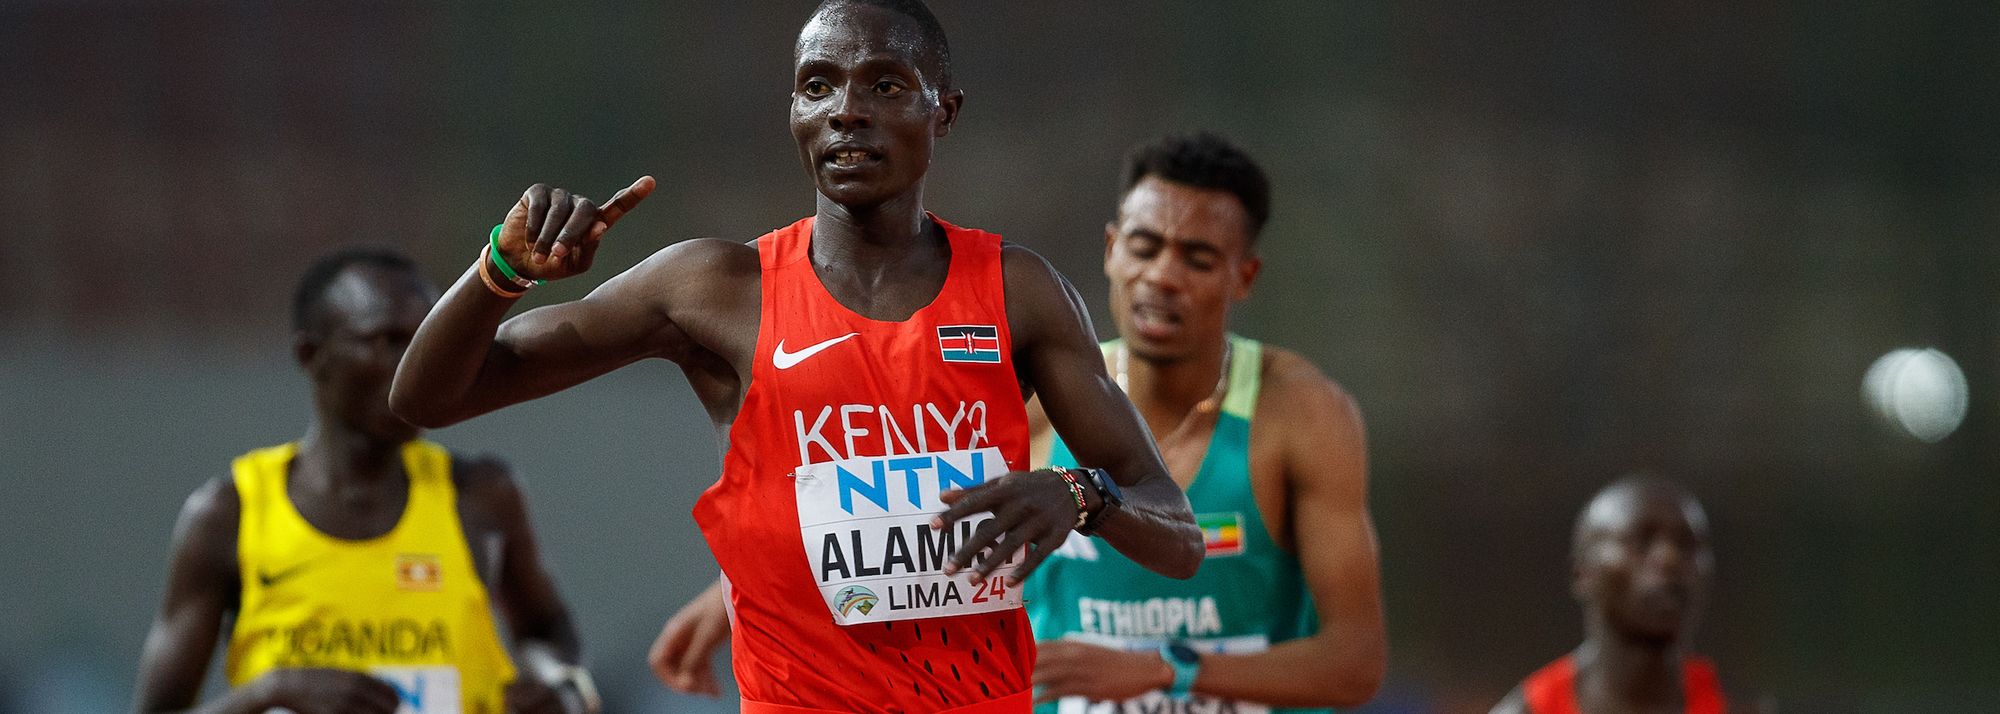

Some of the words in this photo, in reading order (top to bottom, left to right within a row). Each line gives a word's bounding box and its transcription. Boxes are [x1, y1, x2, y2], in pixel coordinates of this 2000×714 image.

[836, 452, 985, 515] NTN
[888, 580, 963, 611] LIMA
[971, 576, 1006, 604] 24
[1079, 597, 1222, 635] ETHIOPIA
